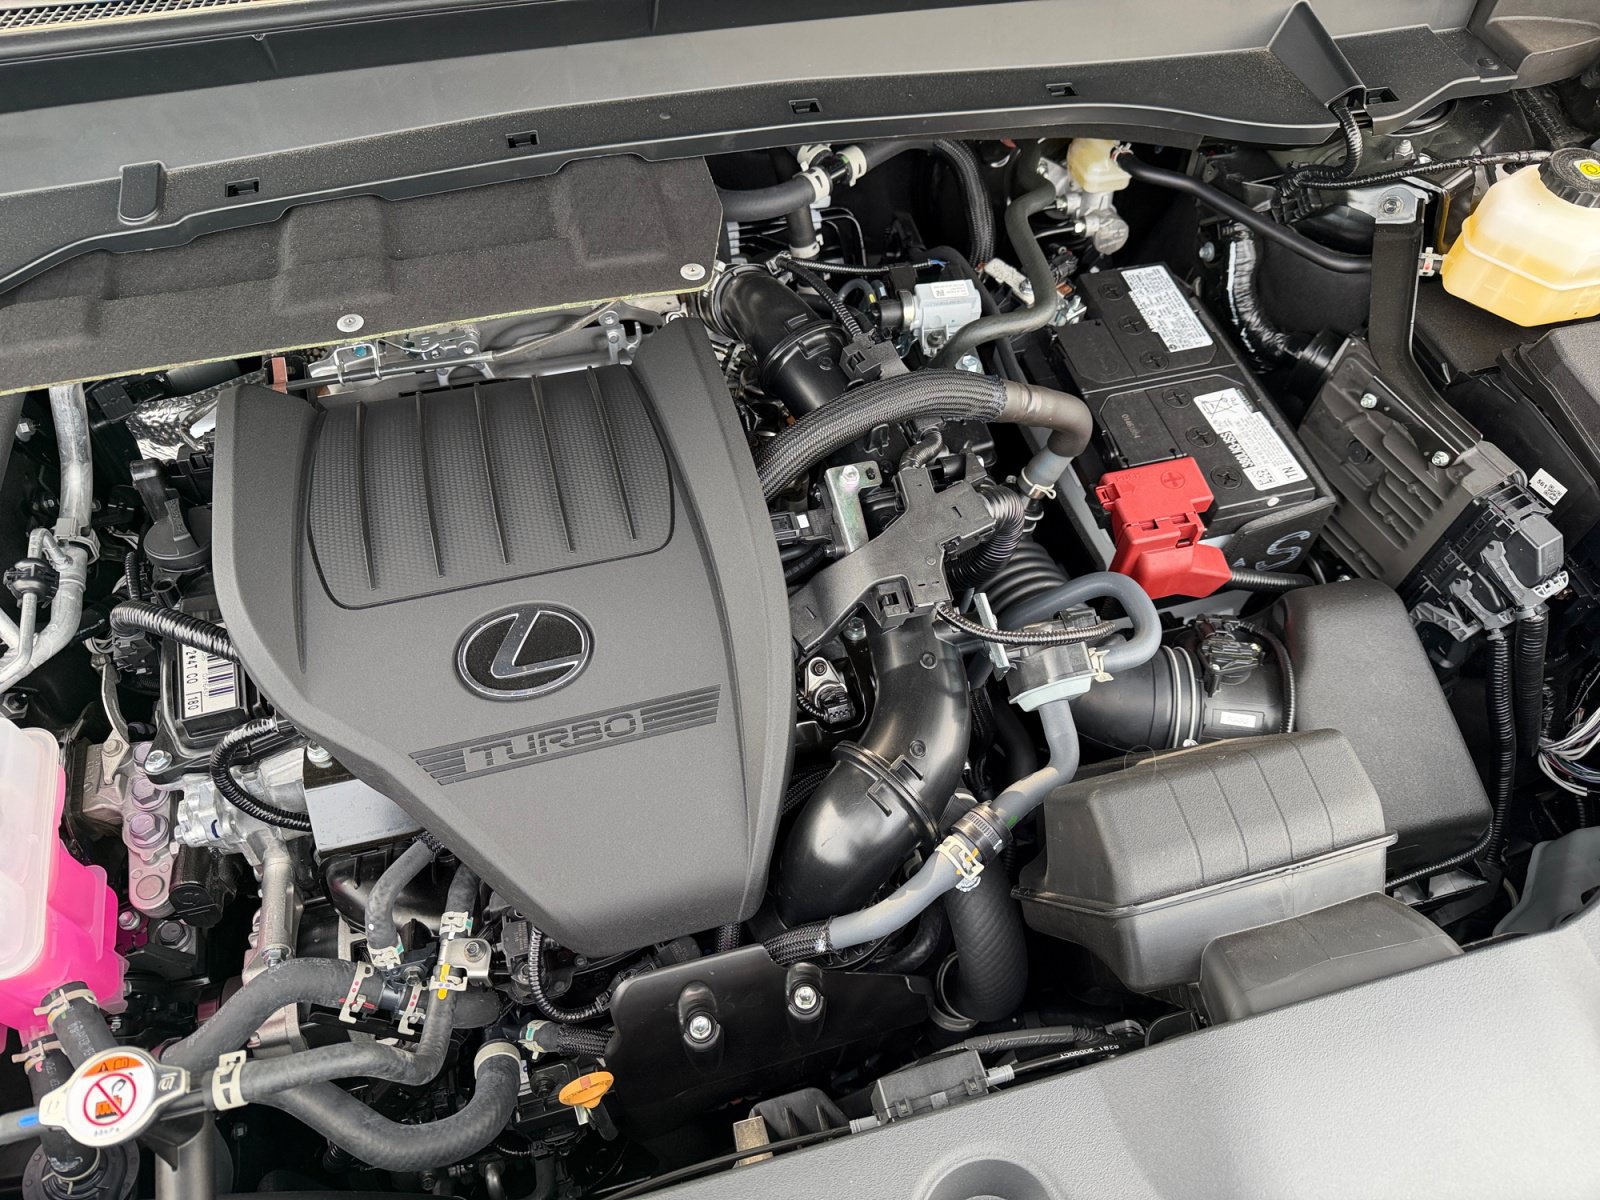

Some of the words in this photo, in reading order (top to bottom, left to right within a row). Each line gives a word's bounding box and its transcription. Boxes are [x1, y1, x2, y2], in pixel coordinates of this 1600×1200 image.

[1536, 478, 1548, 489] 561
[187, 695, 199, 710] 180
[469, 712, 636, 766] TURBO
